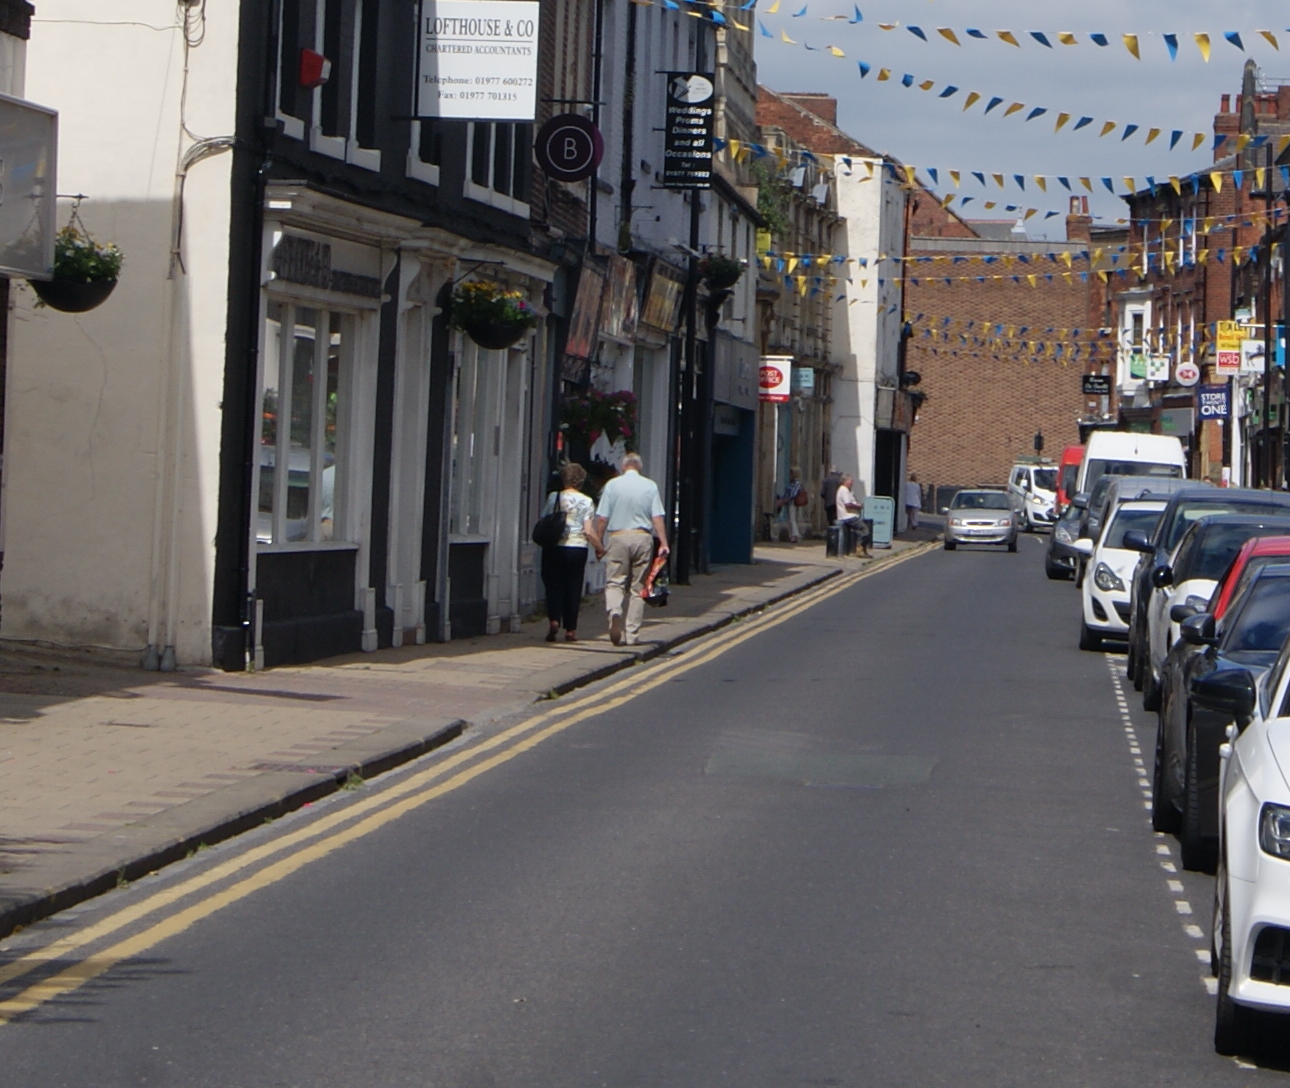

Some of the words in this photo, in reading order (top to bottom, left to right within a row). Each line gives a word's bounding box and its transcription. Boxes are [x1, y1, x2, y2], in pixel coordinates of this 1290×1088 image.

[425, 17, 501, 37] LOFTHOUSE
[504, 19, 513, 37] &
[516, 19, 534, 38] CO
[425, 44, 473, 54] CHARTERED
[474, 45, 532, 56] ACCOUNTANTS
[423, 74, 473, 86] Telephone:
[475, 76, 500, 85] 01977
[502, 77, 533, 87] 600272
[438, 91, 457, 100] Fax:
[459, 91, 484, 100] 01977
[669, 106, 711, 116] Weddings
[563, 137, 578, 160] B
[1201, 405, 1227, 416] ONE
